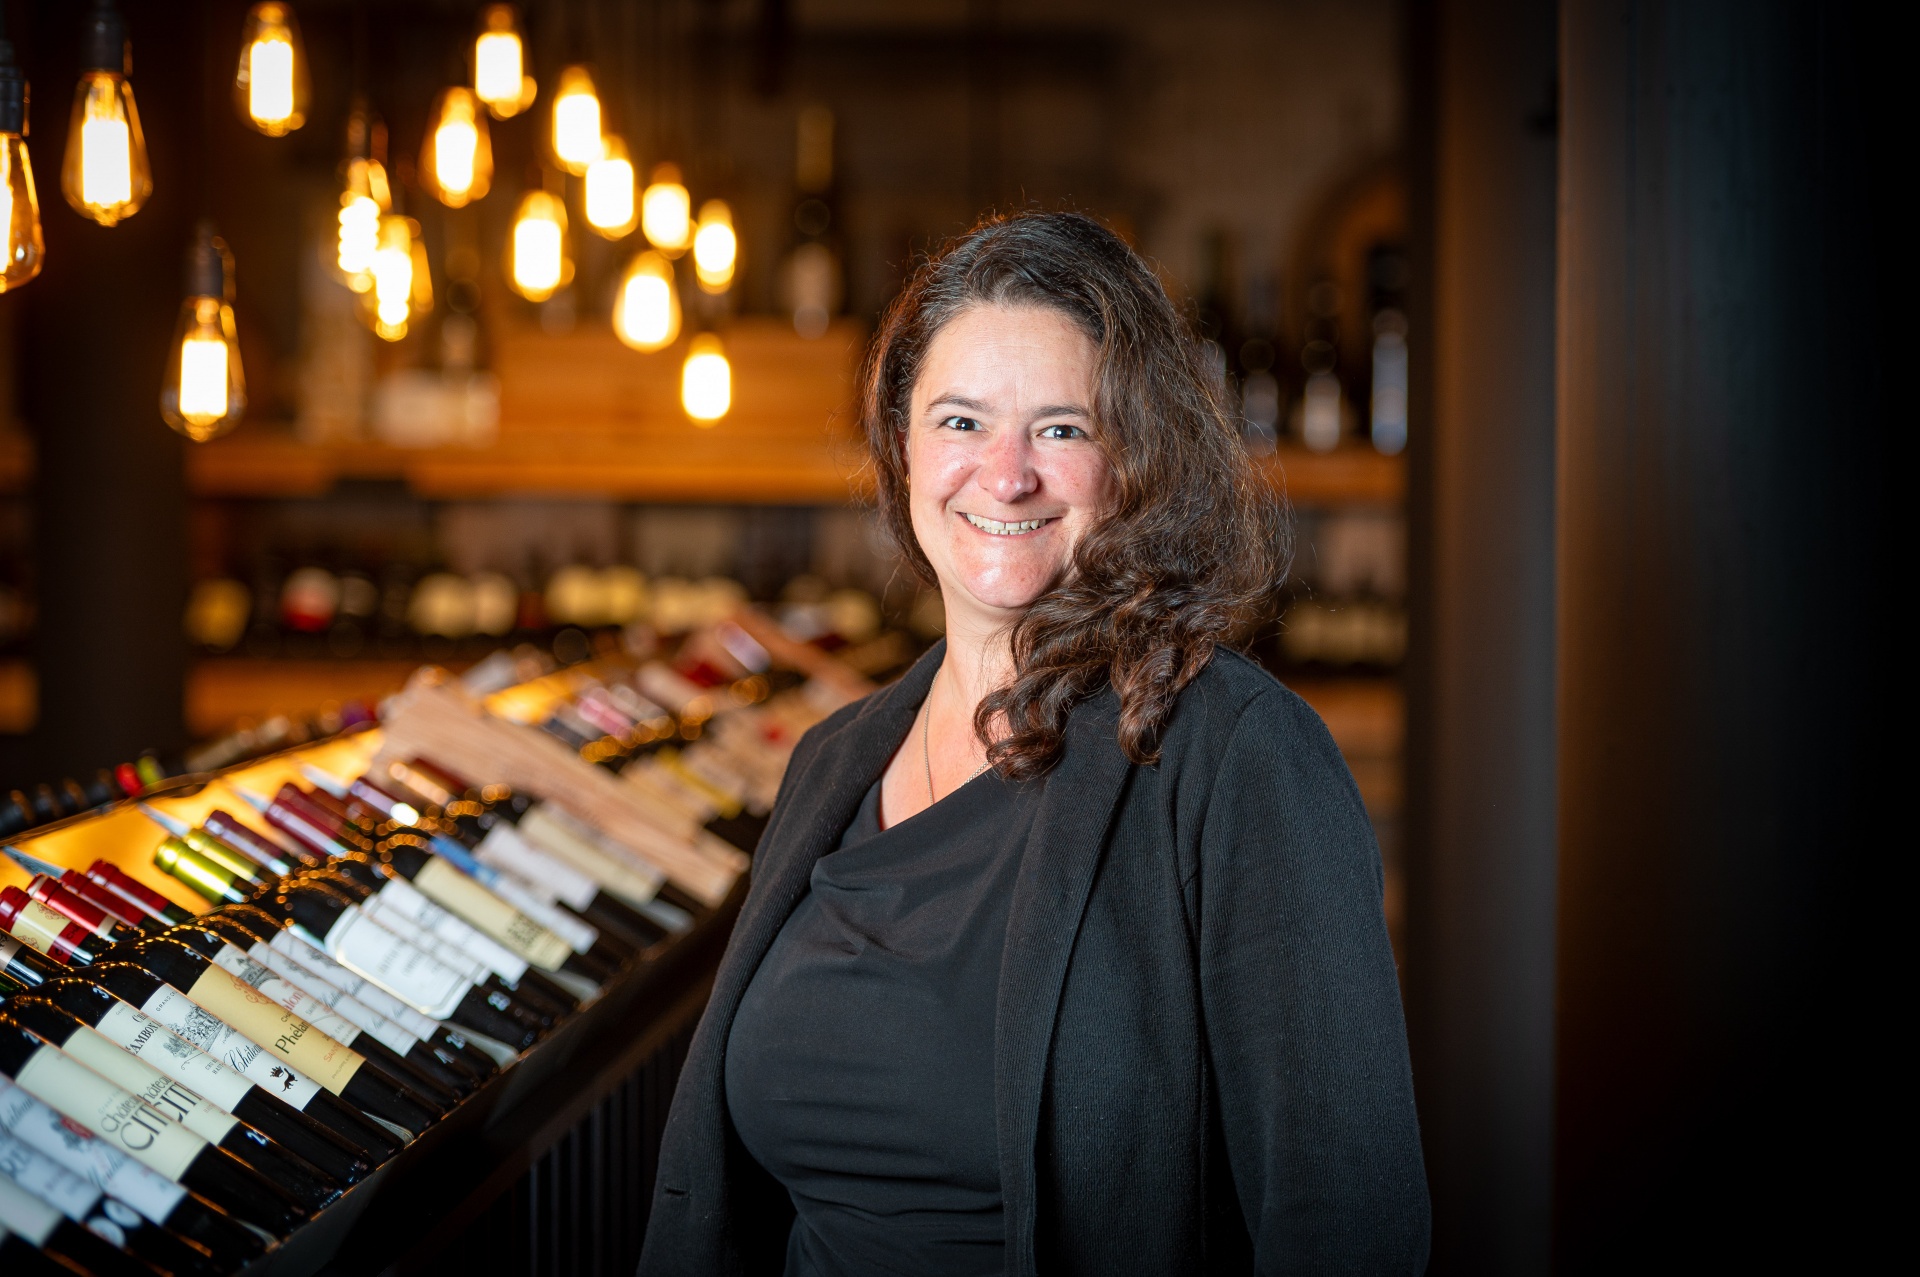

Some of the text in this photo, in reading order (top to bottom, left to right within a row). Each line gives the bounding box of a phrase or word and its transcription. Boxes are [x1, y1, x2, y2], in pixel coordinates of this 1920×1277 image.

[155, 995, 171, 1012] GRAND
[137, 1075, 174, 1105] hâteau
[120, 1103, 169, 1151] CIT
